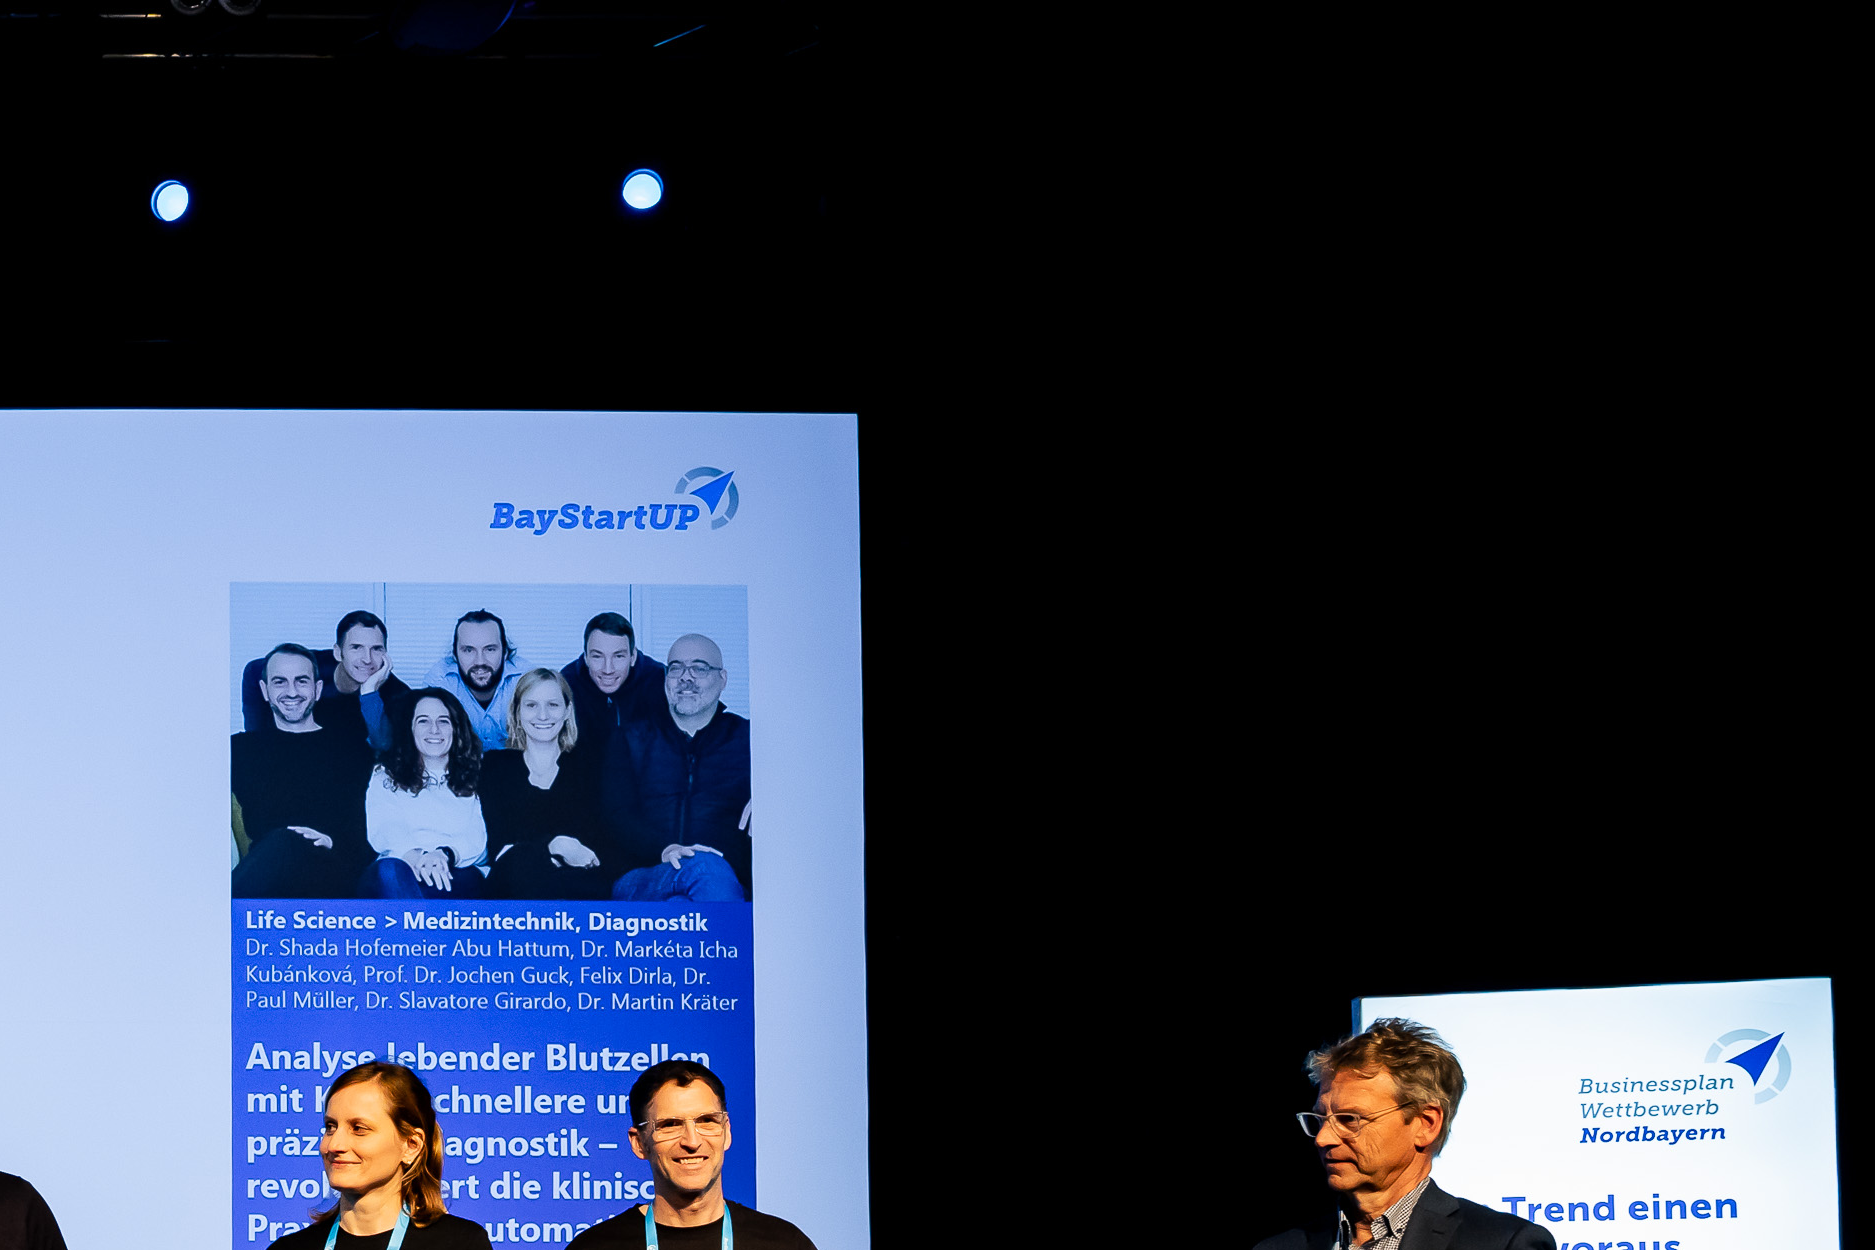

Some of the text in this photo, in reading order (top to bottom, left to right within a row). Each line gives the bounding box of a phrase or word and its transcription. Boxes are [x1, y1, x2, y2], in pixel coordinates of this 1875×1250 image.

[489, 502, 701, 536] BayStartUP
[245, 909, 287, 930] Life
[293, 909, 377, 930] Science
[403, 910, 581, 934] Medizintechnik,
[588, 911, 709, 937] Diagnostik
[245, 937, 739, 961] Dr. Shada Hofemeier Abu Hattum, Dr. Markéta Icha
[245, 964, 711, 988] Kubánková, Prof. Dr. Jochen Guck, Felix Dirla, Dr.
[245, 990, 739, 1013] Paul Müller, Dr. Slavatore Girardo, Dr. Martin Kräter
[246, 1041, 376, 1078] Analyse
[387, 1041, 535, 1071] lebender
[247, 1084, 304, 1113] mit
[1578, 1074, 1735, 1095] Businessplan
[1580, 1099, 1720, 1119] Wettbewerb
[247, 1127, 326, 1164] präz
[1579, 1125, 1726, 1146] Nordbayern
[489, 1170, 542, 1200] die
[1501, 1193, 1738, 1223] Trend einen
